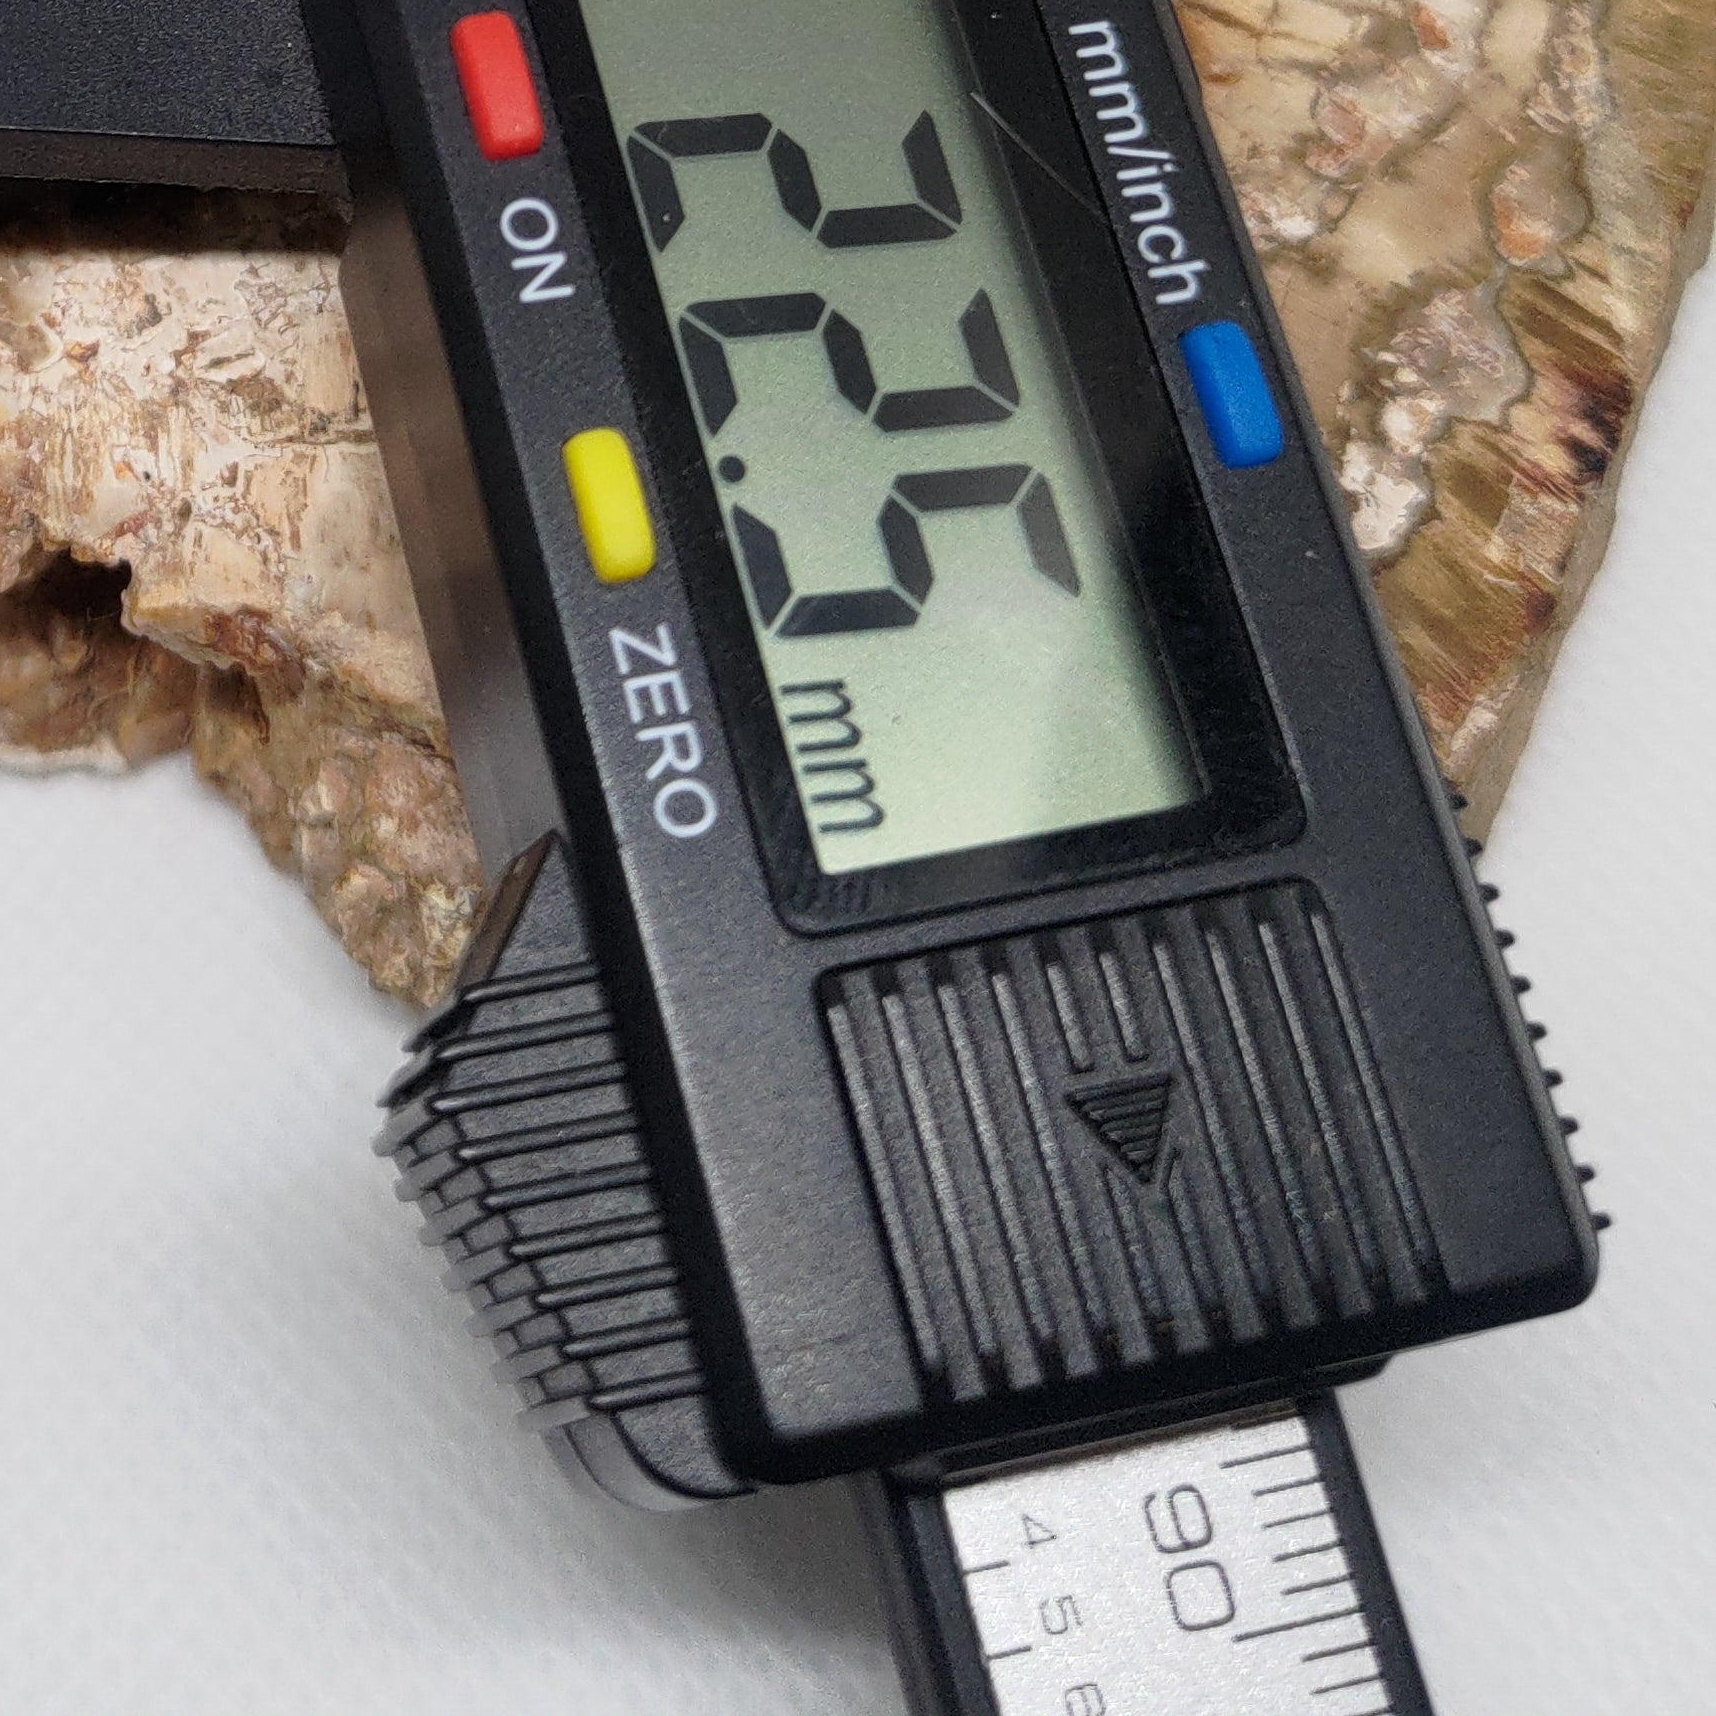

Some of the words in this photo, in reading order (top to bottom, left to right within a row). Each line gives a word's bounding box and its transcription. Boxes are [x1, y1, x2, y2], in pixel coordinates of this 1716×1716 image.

[1068, 20, 1210, 305] mm/inch
[499, 197, 576, 304] ON
[627, 110, 1082, 639] 22.5
[608, 621, 717, 838] ZERO
[780, 678, 887, 834] mm
[1021, 1514, 1058, 1550] 4
[1143, 1484, 1236, 1631] 90
[1039, 1594, 1083, 1635] 5
